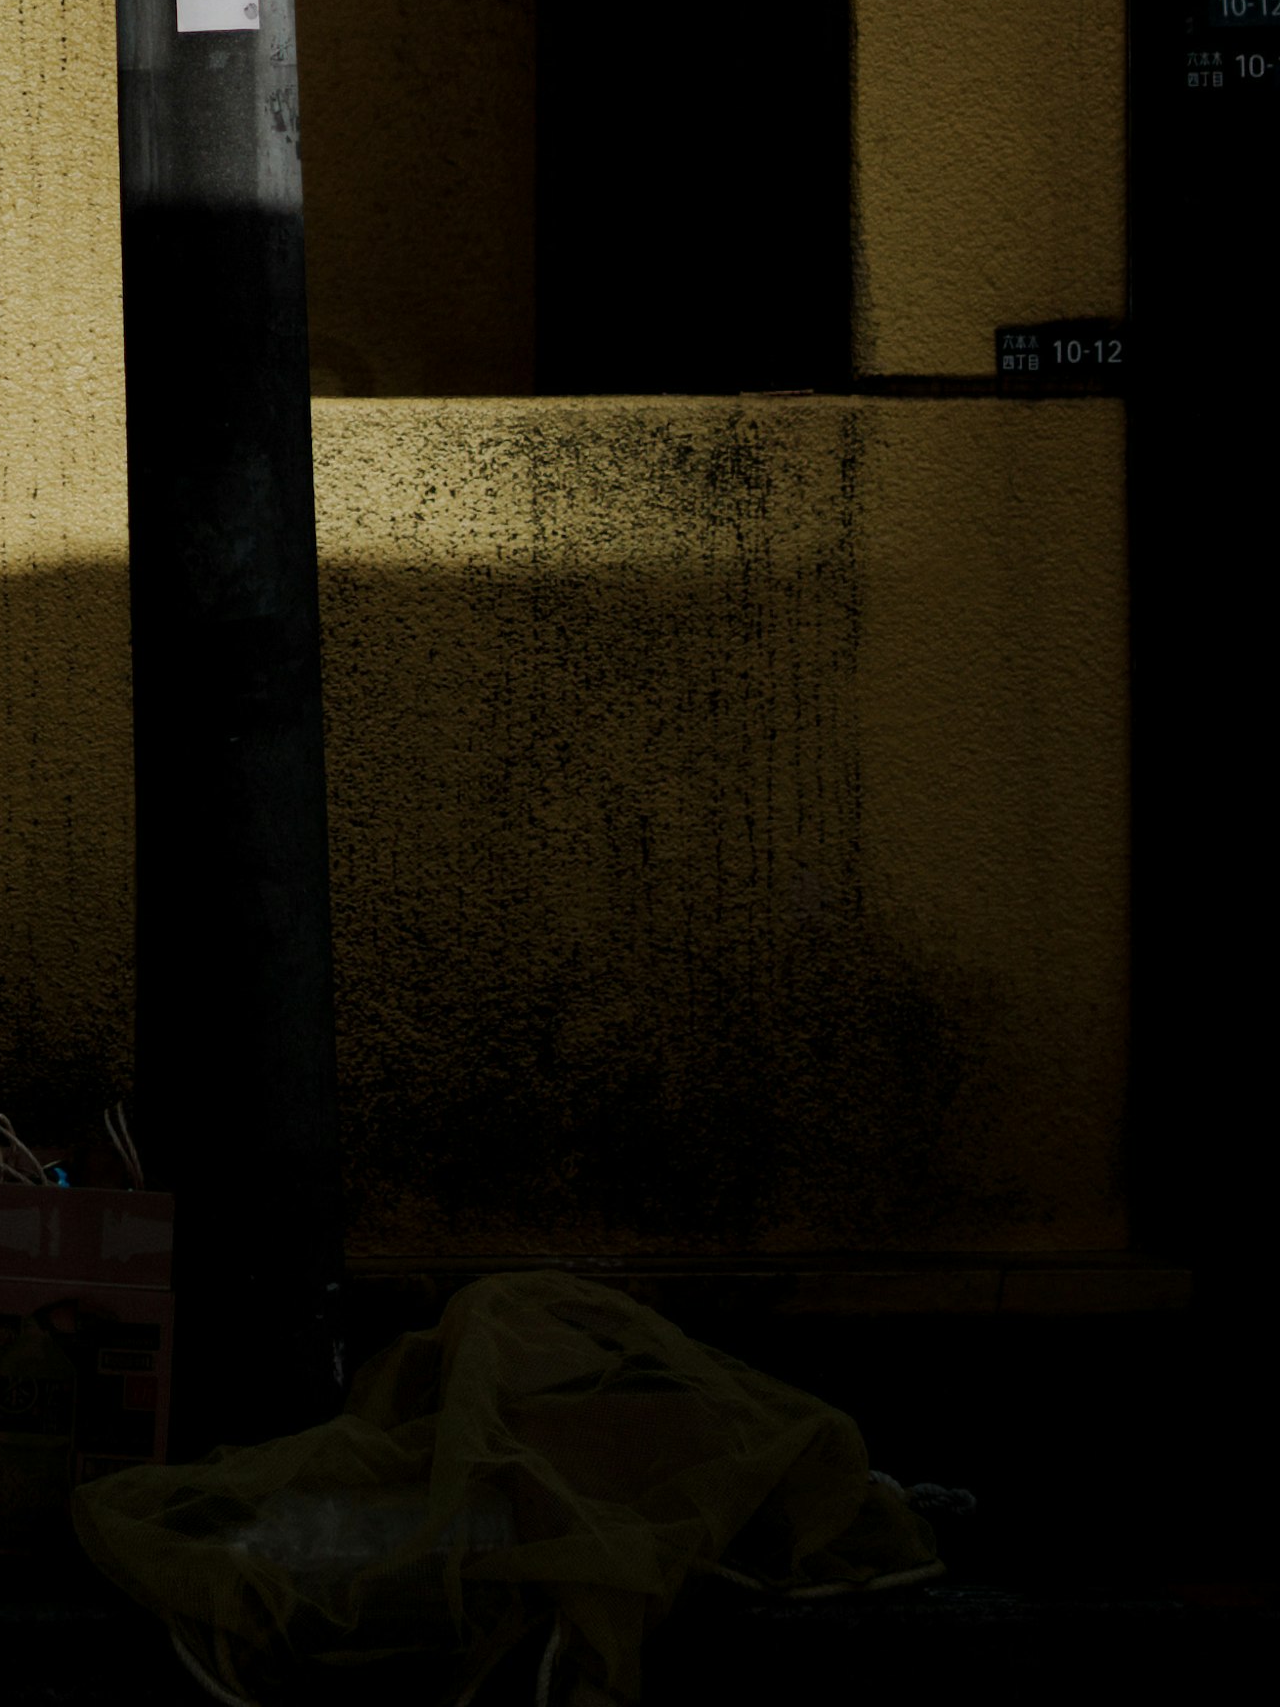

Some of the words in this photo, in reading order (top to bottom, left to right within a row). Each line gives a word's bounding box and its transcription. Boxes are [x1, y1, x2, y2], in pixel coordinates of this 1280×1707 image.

[1234, 53, 1280, 78] 10-
[1187, 71, 1223, 87] 四丁目
[1052, 338, 1123, 364] 10-12
[1002, 353, 1040, 371] 四丁目
